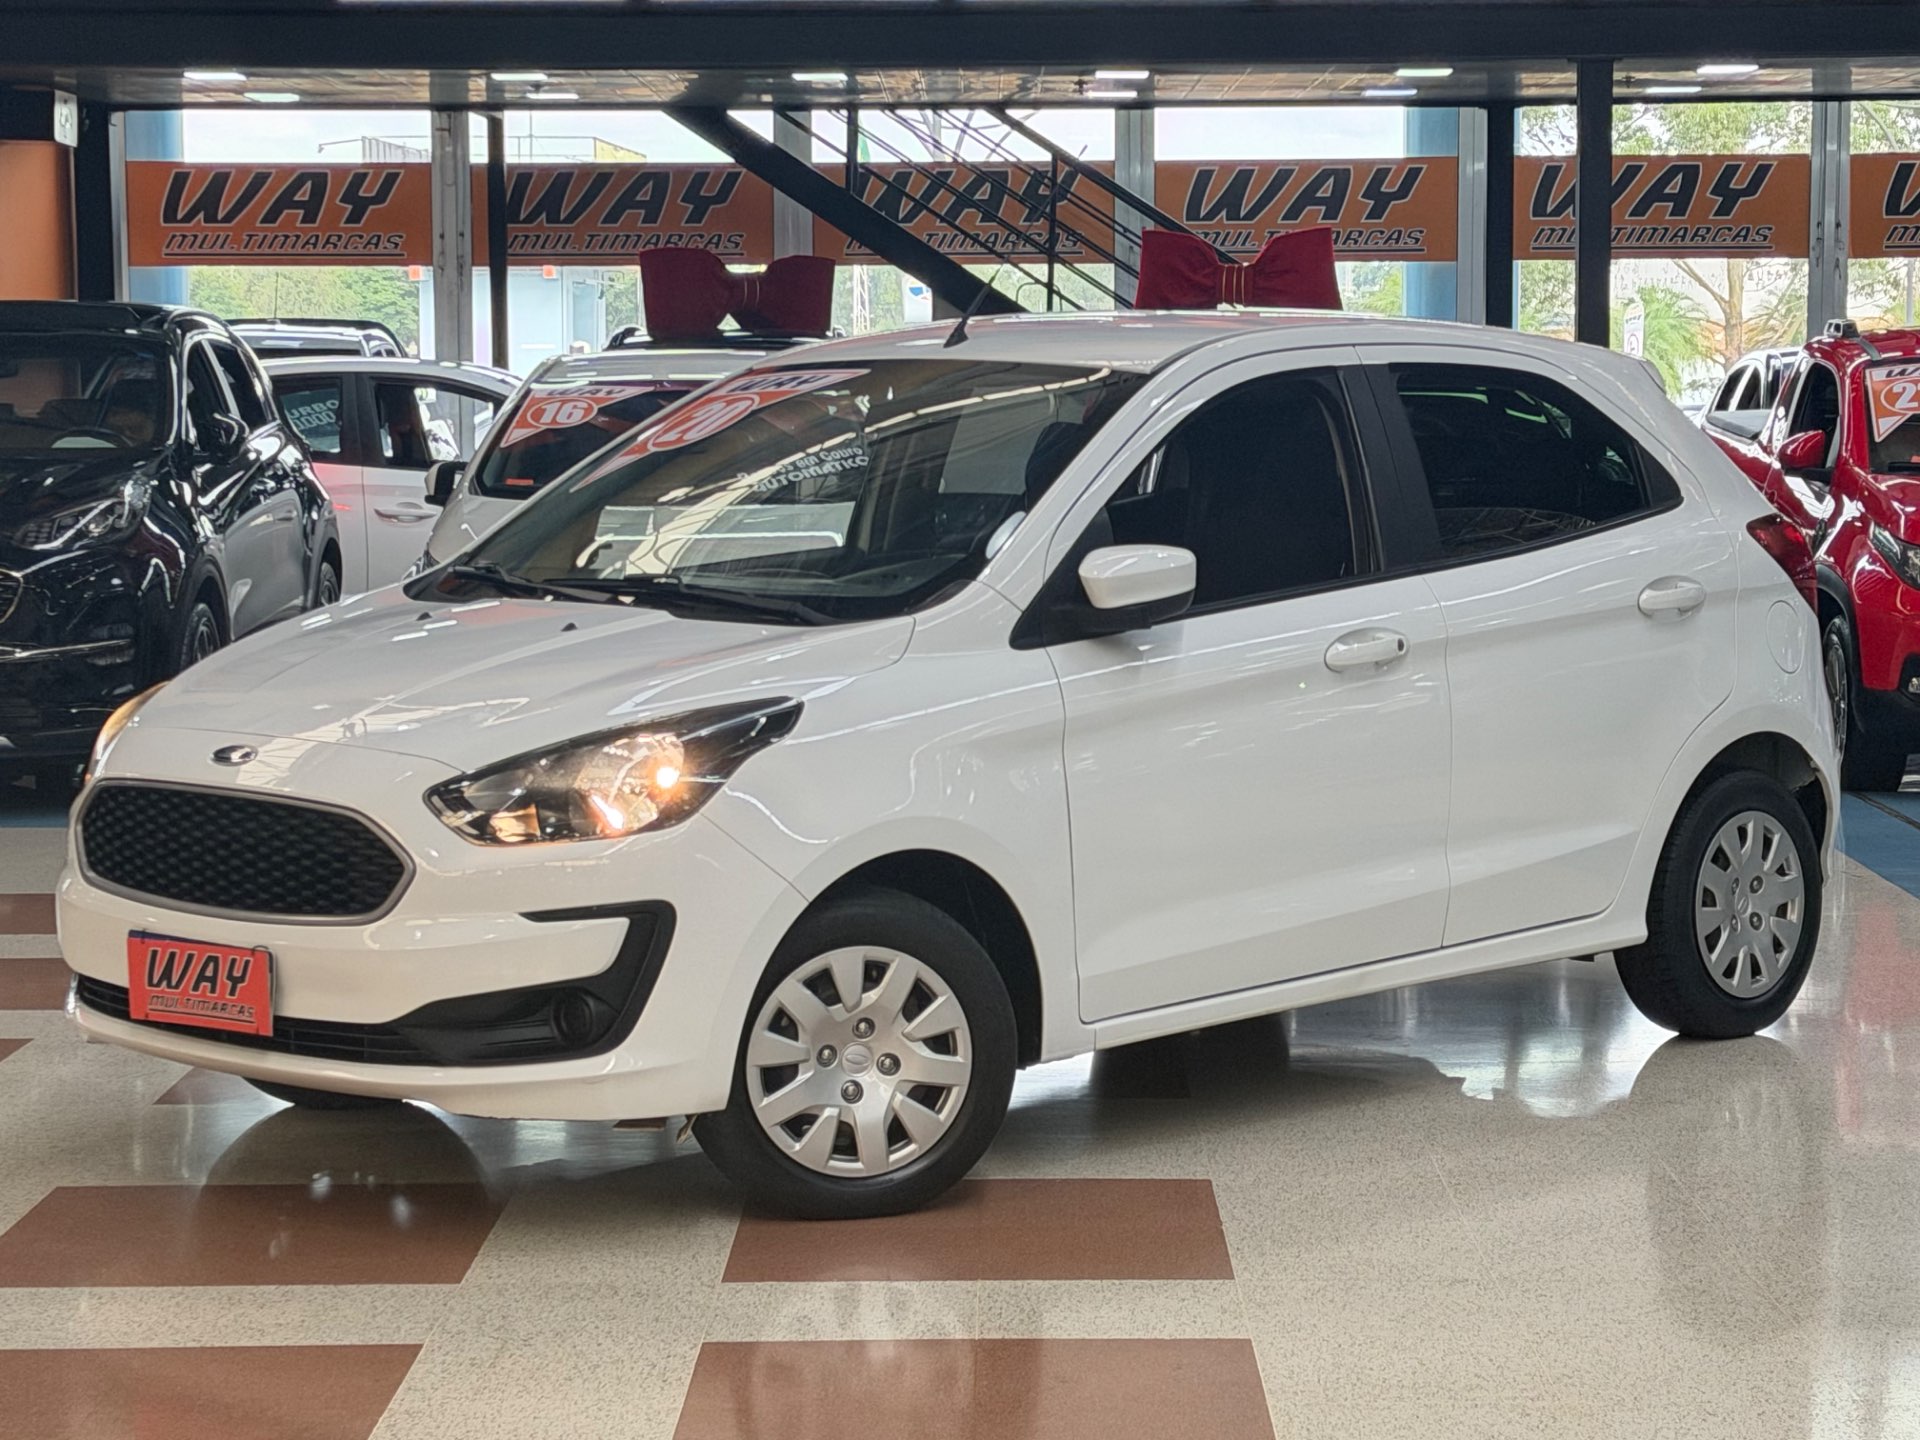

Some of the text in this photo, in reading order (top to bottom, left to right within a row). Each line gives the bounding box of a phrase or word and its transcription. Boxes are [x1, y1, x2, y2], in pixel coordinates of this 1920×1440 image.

[161, 169, 404, 227] WAY
[507, 169, 746, 227] WAY
[1184, 164, 1428, 224] WAY
[162, 232, 407, 251] MULTIMARCAS
[507, 232, 746, 251] MULTIMARCAS
[1531, 225, 1775, 245] MTIMARCAS
[728, 375, 831, 392] WAY
[292, 410, 336, 430] 1000
[539, 400, 589, 424] 16
[654, 400, 754, 442] 20
[819, 446, 863, 462] Couro
[146, 948, 253, 998] WAY
[149, 994, 254, 1019] MULTIMARCAS
